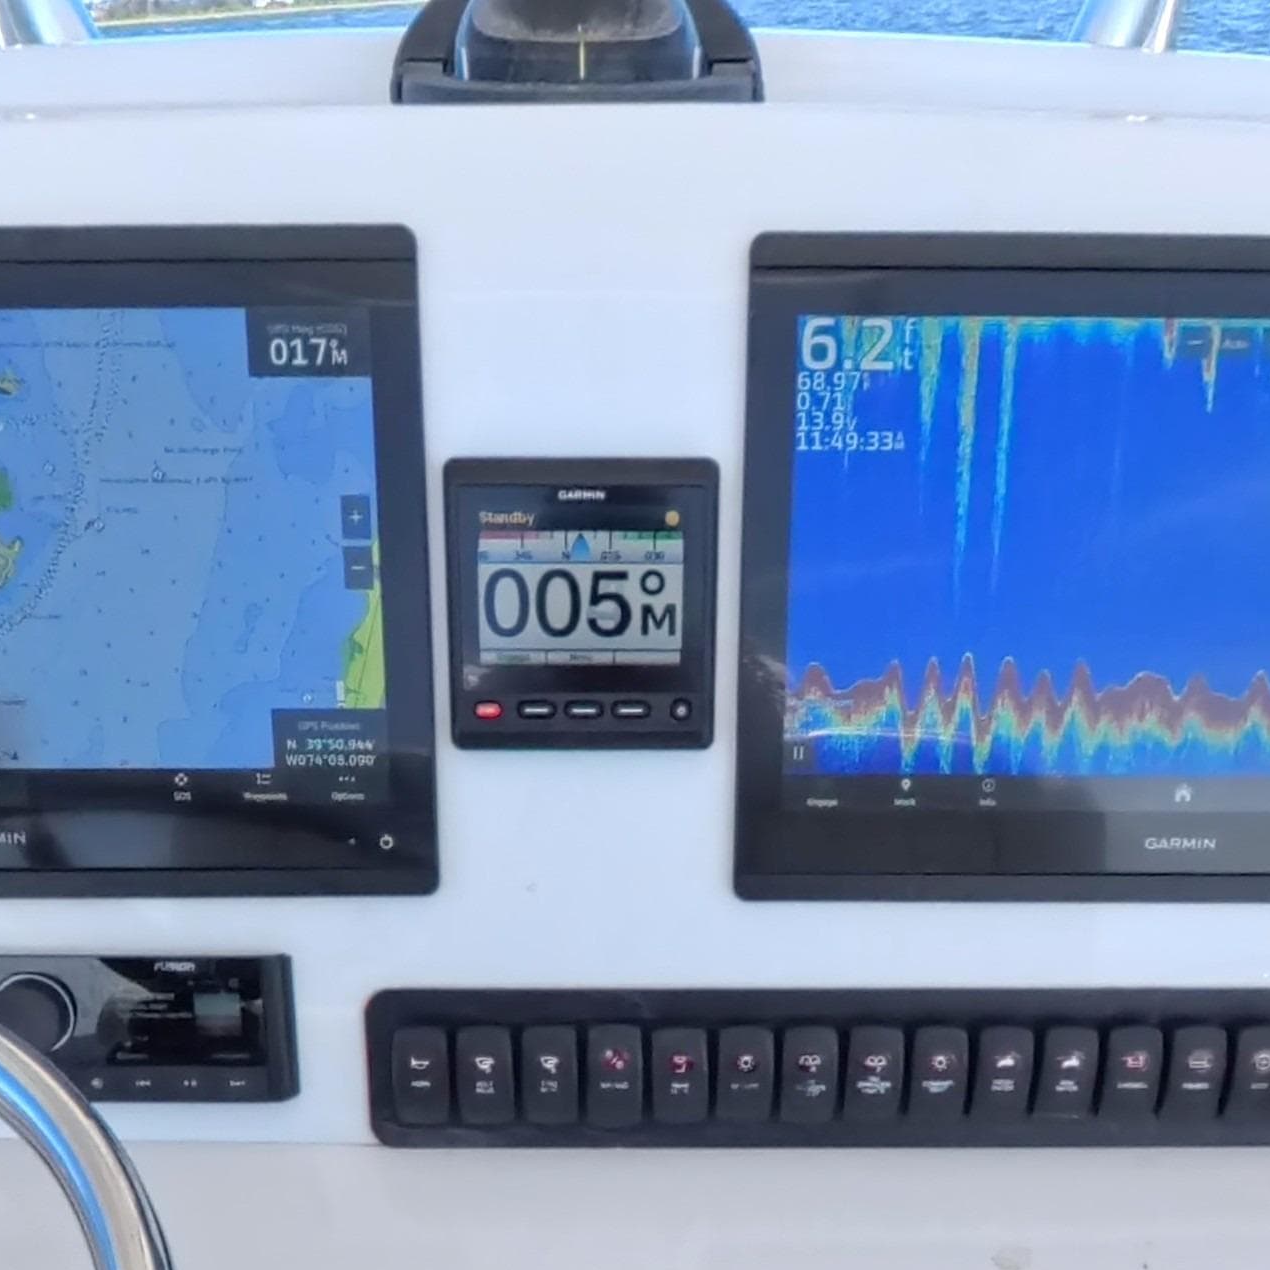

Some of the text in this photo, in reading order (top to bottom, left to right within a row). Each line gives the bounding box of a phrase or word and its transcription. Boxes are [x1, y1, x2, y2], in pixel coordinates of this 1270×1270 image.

[802, 317, 894, 371] 6.2
[557, 489, 606, 501] GARMIN
[479, 511, 535, 526] Standby
[1144, 837, 1218, 850] GARMIN
